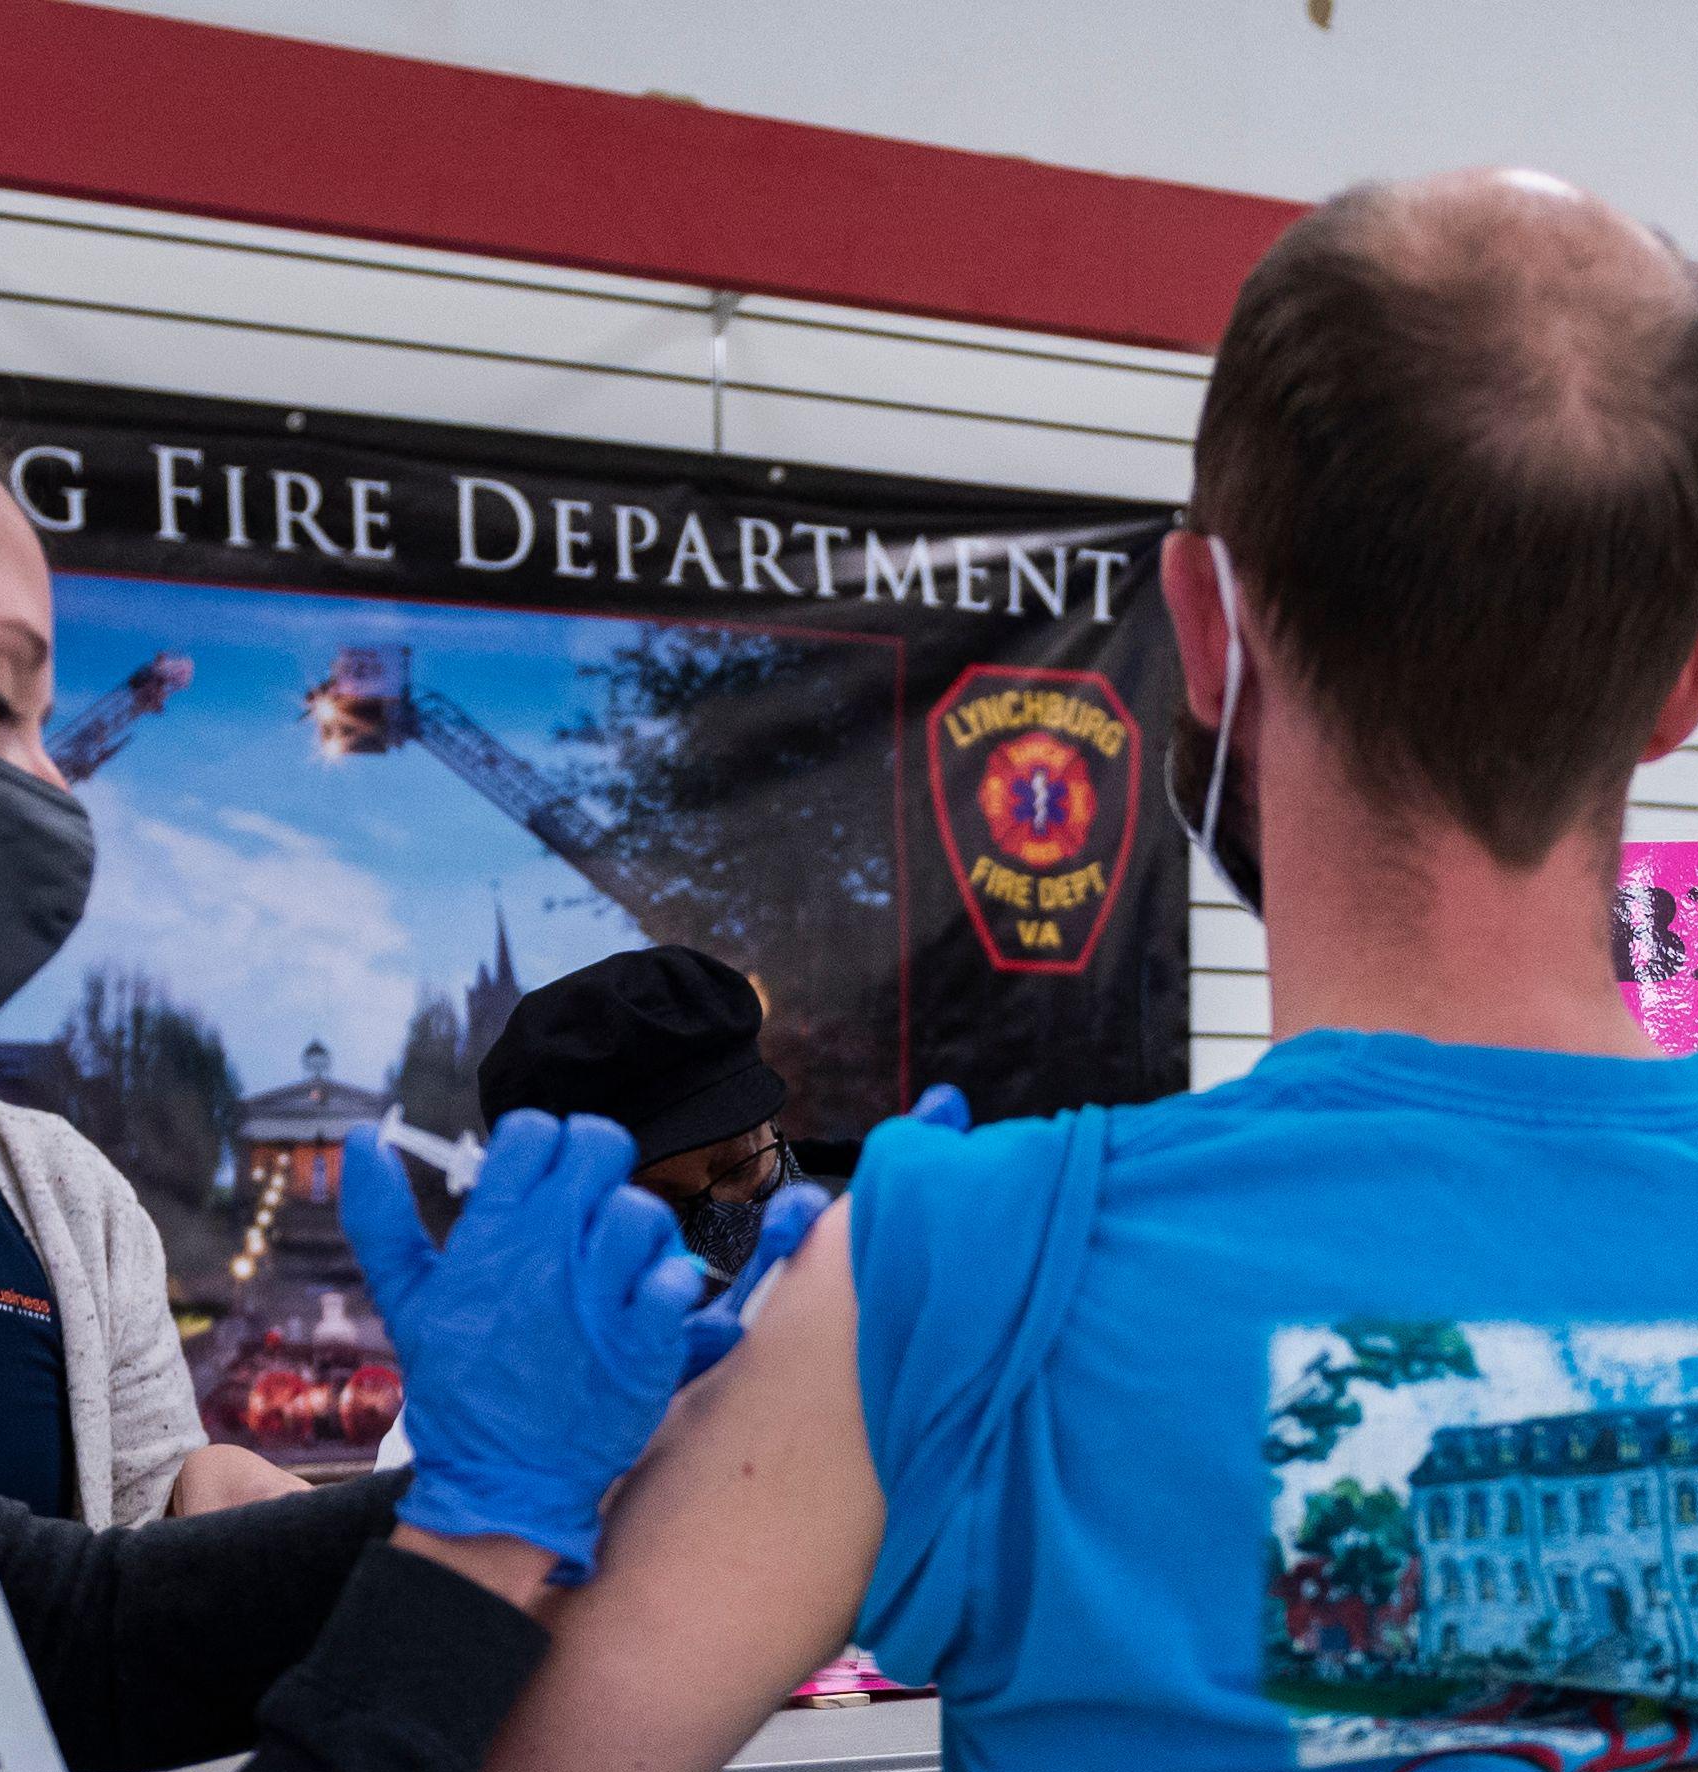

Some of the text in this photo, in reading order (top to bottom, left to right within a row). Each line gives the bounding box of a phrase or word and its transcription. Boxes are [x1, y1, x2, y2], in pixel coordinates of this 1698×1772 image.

[151, 443, 396, 560] FIRE
[452, 475, 1130, 622] DEPARTMENT
[943, 690, 1127, 758] LYNCHBURG
[969, 855, 1034, 909] FIRE
[1016, 919, 1062, 949] VA
